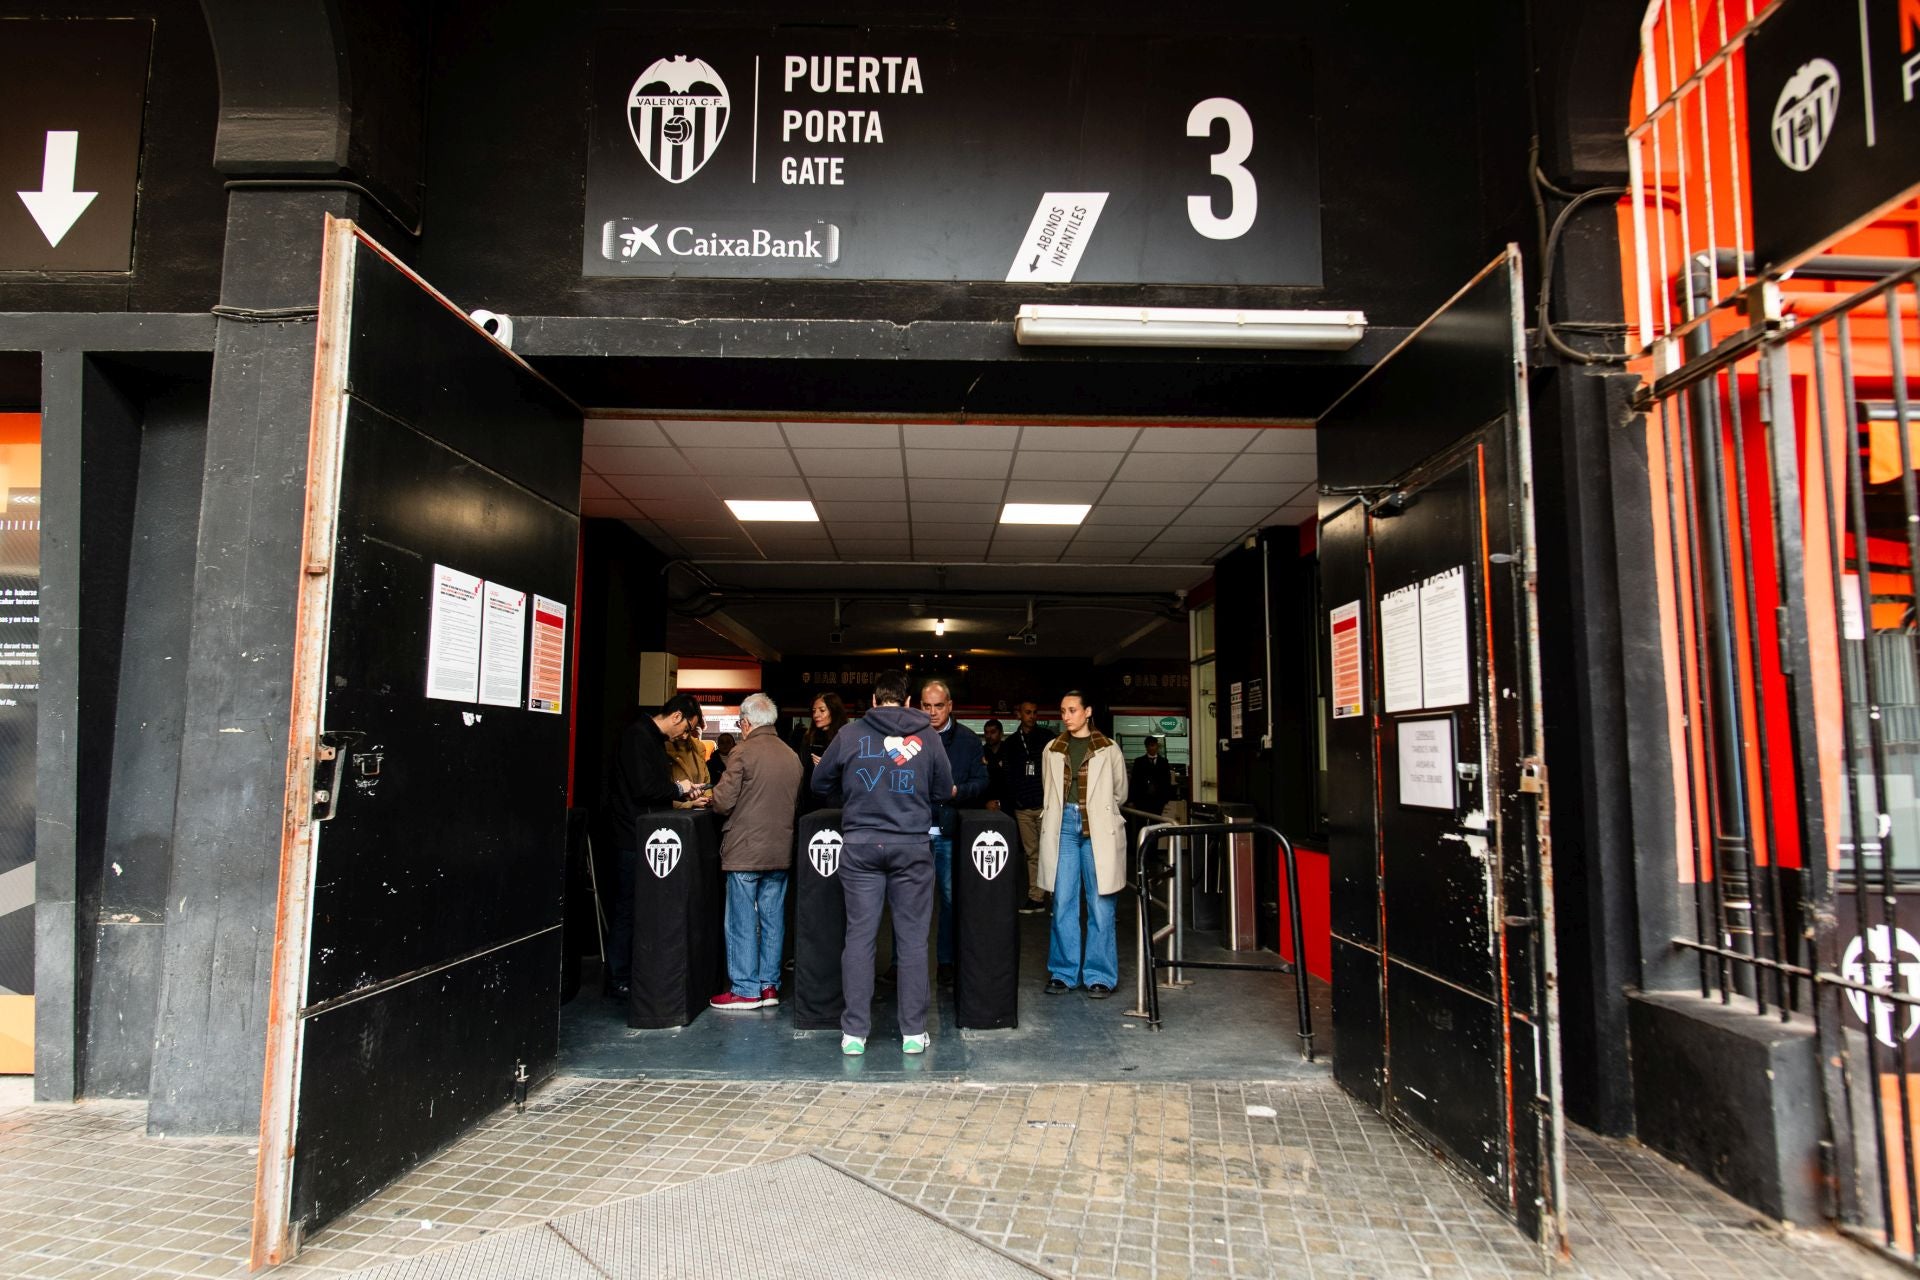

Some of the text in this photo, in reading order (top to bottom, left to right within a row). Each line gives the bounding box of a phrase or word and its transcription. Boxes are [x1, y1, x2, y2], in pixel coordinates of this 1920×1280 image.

[784, 55, 924, 94] PUERTA
[637, 98, 722, 106] VALENCIA C.F.
[782, 110, 884, 143] PORTA
[781, 156, 845, 185] GATE
[1186, 97, 1258, 240] 3
[666, 226, 823, 259] CaixaBank
[1036, 206, 1065, 251] ABONOS
[1050, 205, 1087, 266] INFANTILES
